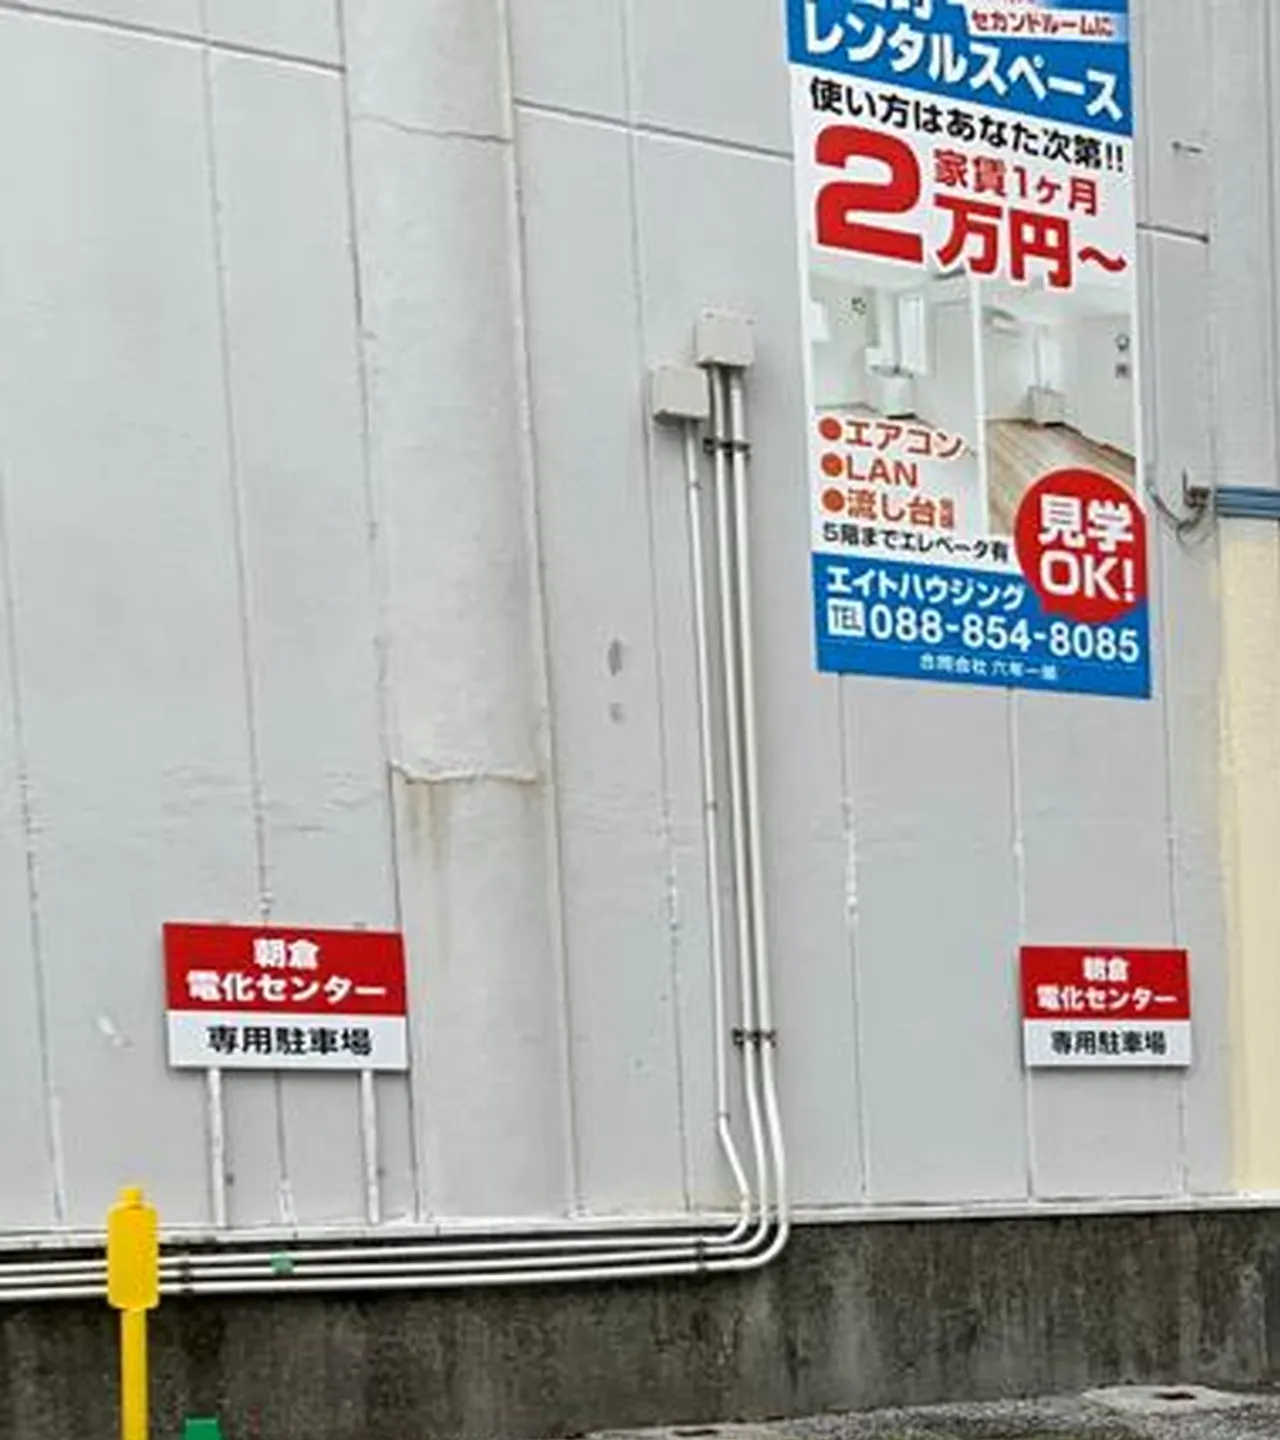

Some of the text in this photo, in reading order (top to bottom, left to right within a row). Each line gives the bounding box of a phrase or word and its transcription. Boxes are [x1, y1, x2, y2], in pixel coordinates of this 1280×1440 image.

[805, 1, 1123, 122] レンタルスペース
[846, 420, 962, 458] エアコン
[846, 455, 917, 486] LAN
[1038, 494, 1134, 552] 見学
[826, 566, 1025, 611] エイトハウジング
[1040, 551, 1135, 603] OK!
[870, 604, 1139, 663] 088-854-8085
[253, 939, 320, 970] 朝倉
[186, 970, 387, 1004] 電化センター
[1036, 985, 1177, 1011] 電化センター
[207, 1025, 372, 1056] 専用駐車場
[1051, 1030, 1168, 1055] 専用駐車場
